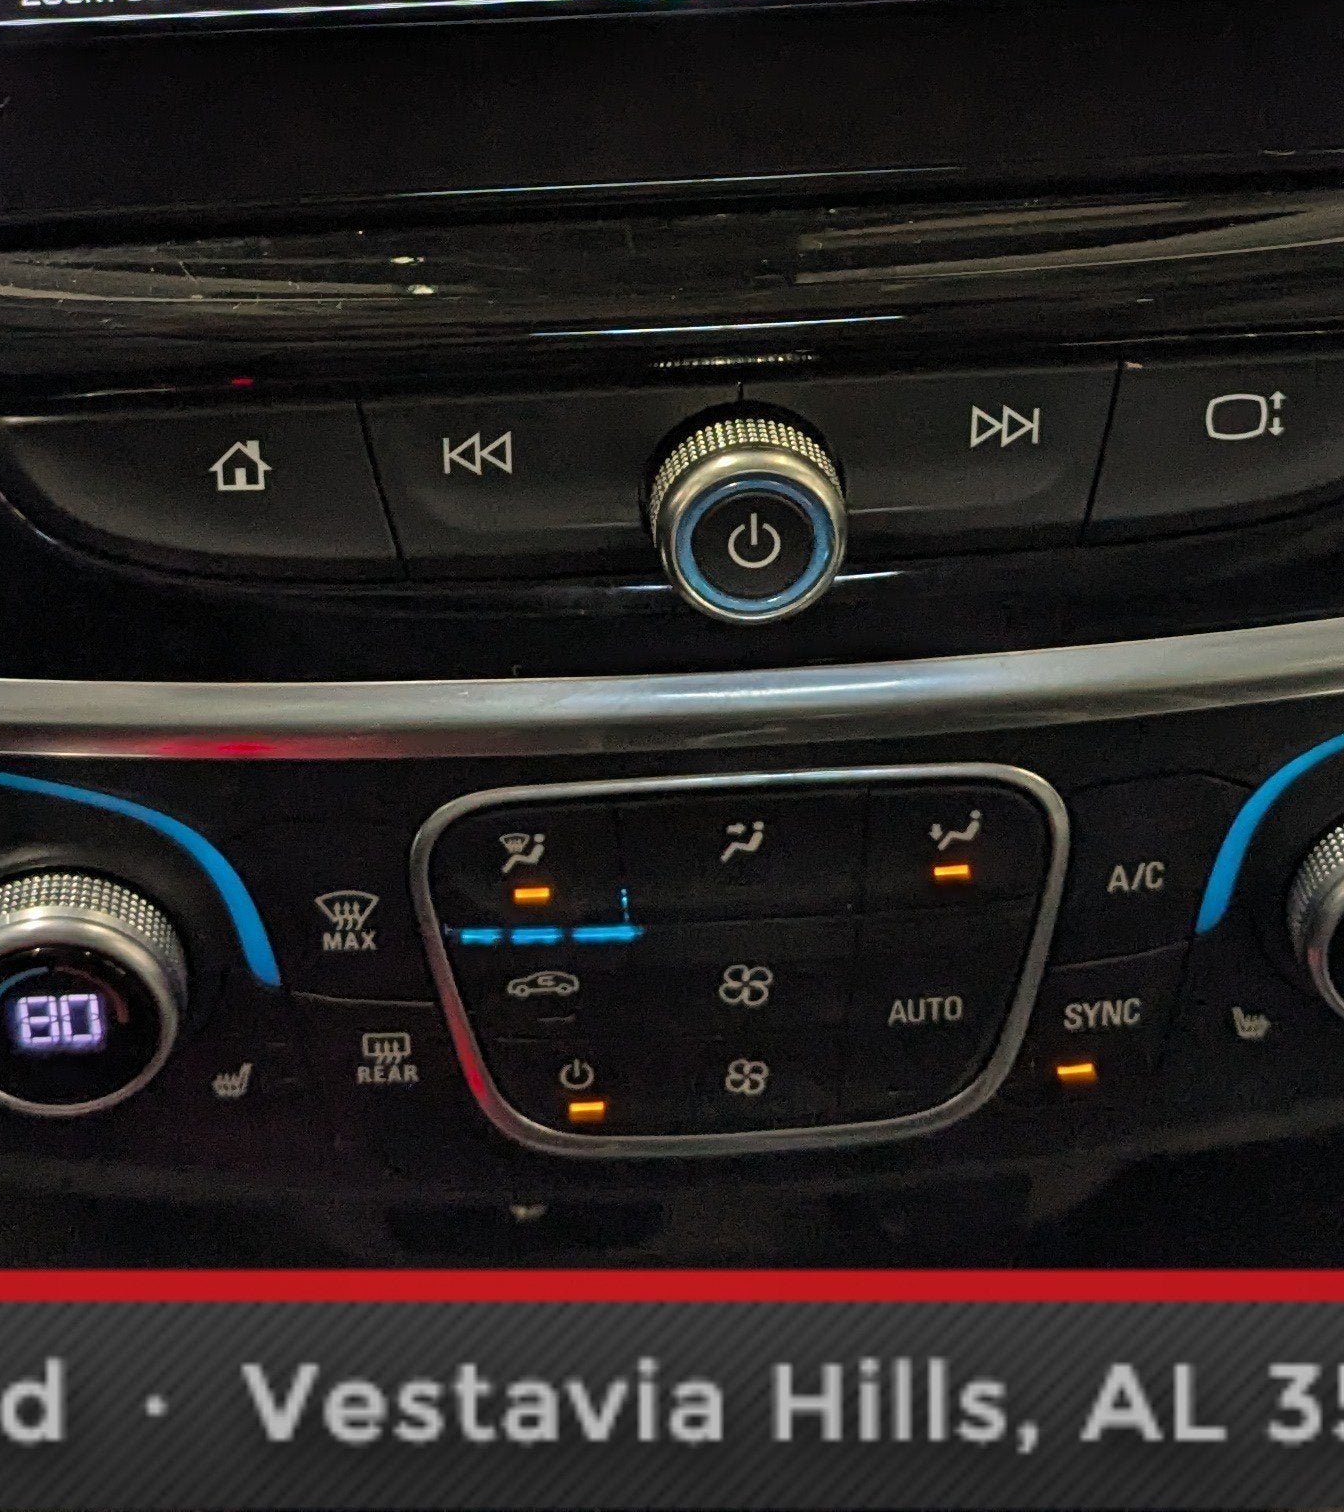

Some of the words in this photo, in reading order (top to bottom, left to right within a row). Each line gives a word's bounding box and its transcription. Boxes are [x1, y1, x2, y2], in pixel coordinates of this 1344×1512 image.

[1106, 860, 1167, 894] A/C
[321, 929, 379, 954] MAX
[13, 991, 106, 1048] 80
[887, 994, 965, 1026] AUTO
[1063, 997, 1143, 1032] SYNC
[357, 1062, 420, 1087] REAR
